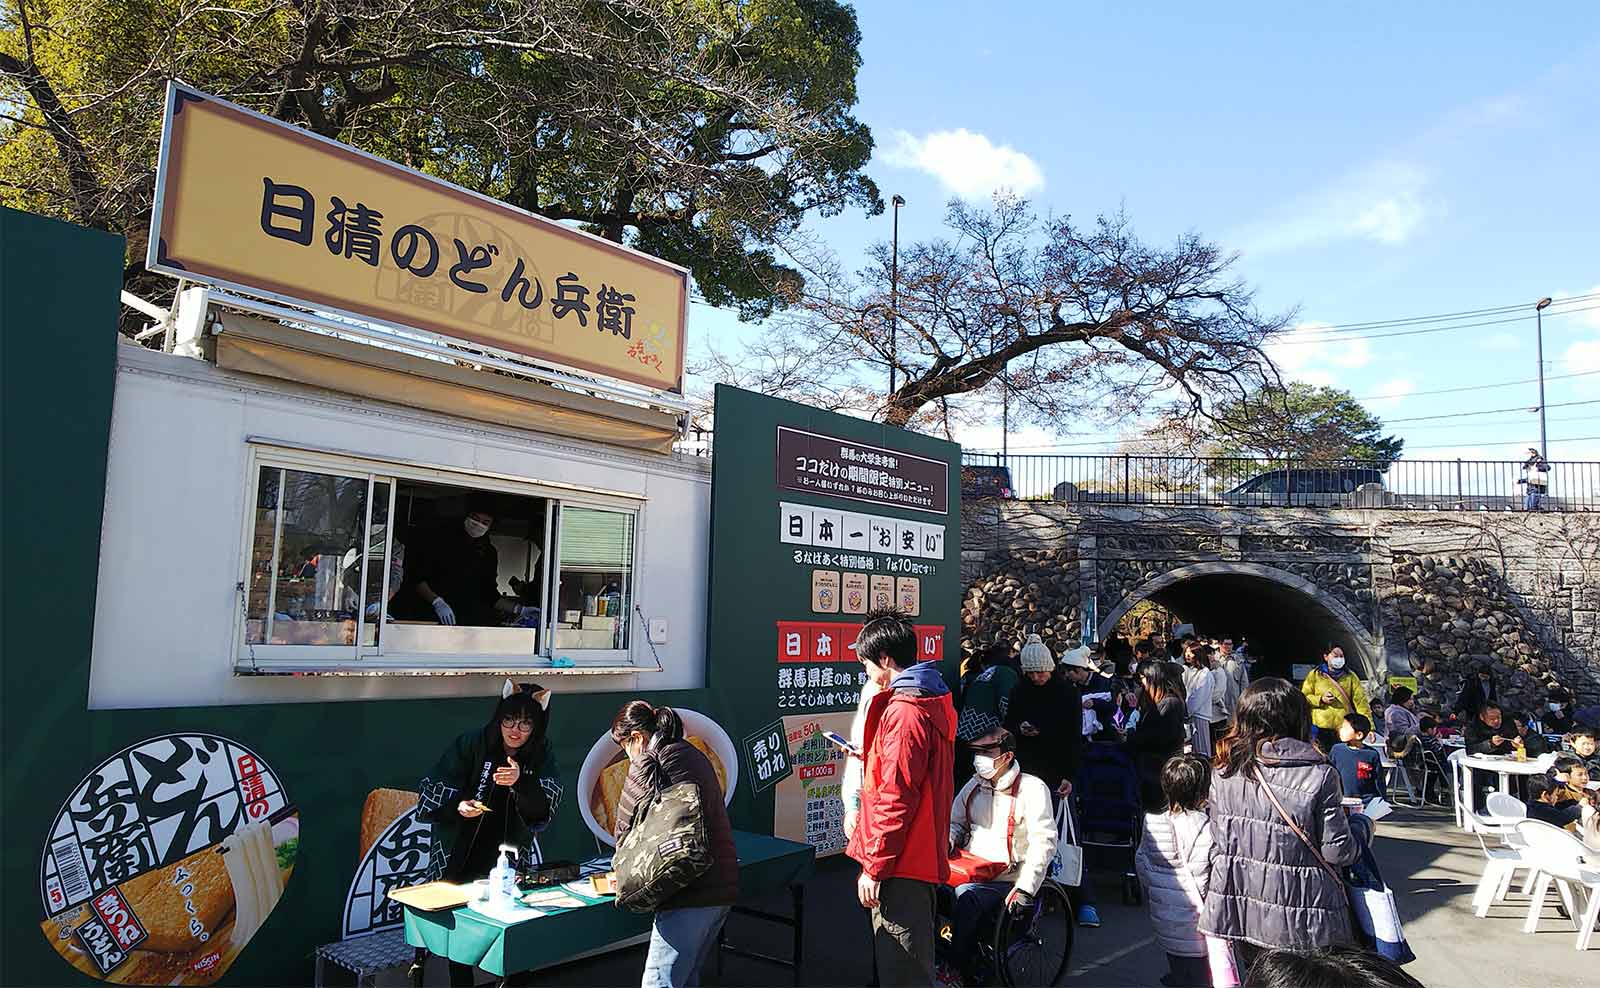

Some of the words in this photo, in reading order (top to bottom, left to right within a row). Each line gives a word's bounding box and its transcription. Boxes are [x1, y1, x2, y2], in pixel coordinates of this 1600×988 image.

[260, 177, 636, 341] 日清のどん兵衛
[752, 731, 780, 763] 売り
[757, 752, 786, 781] 切れ
[237, 753, 270, 819] 日清の
[99, 894, 141, 946] きつね
[83, 921, 124, 970] うどん
